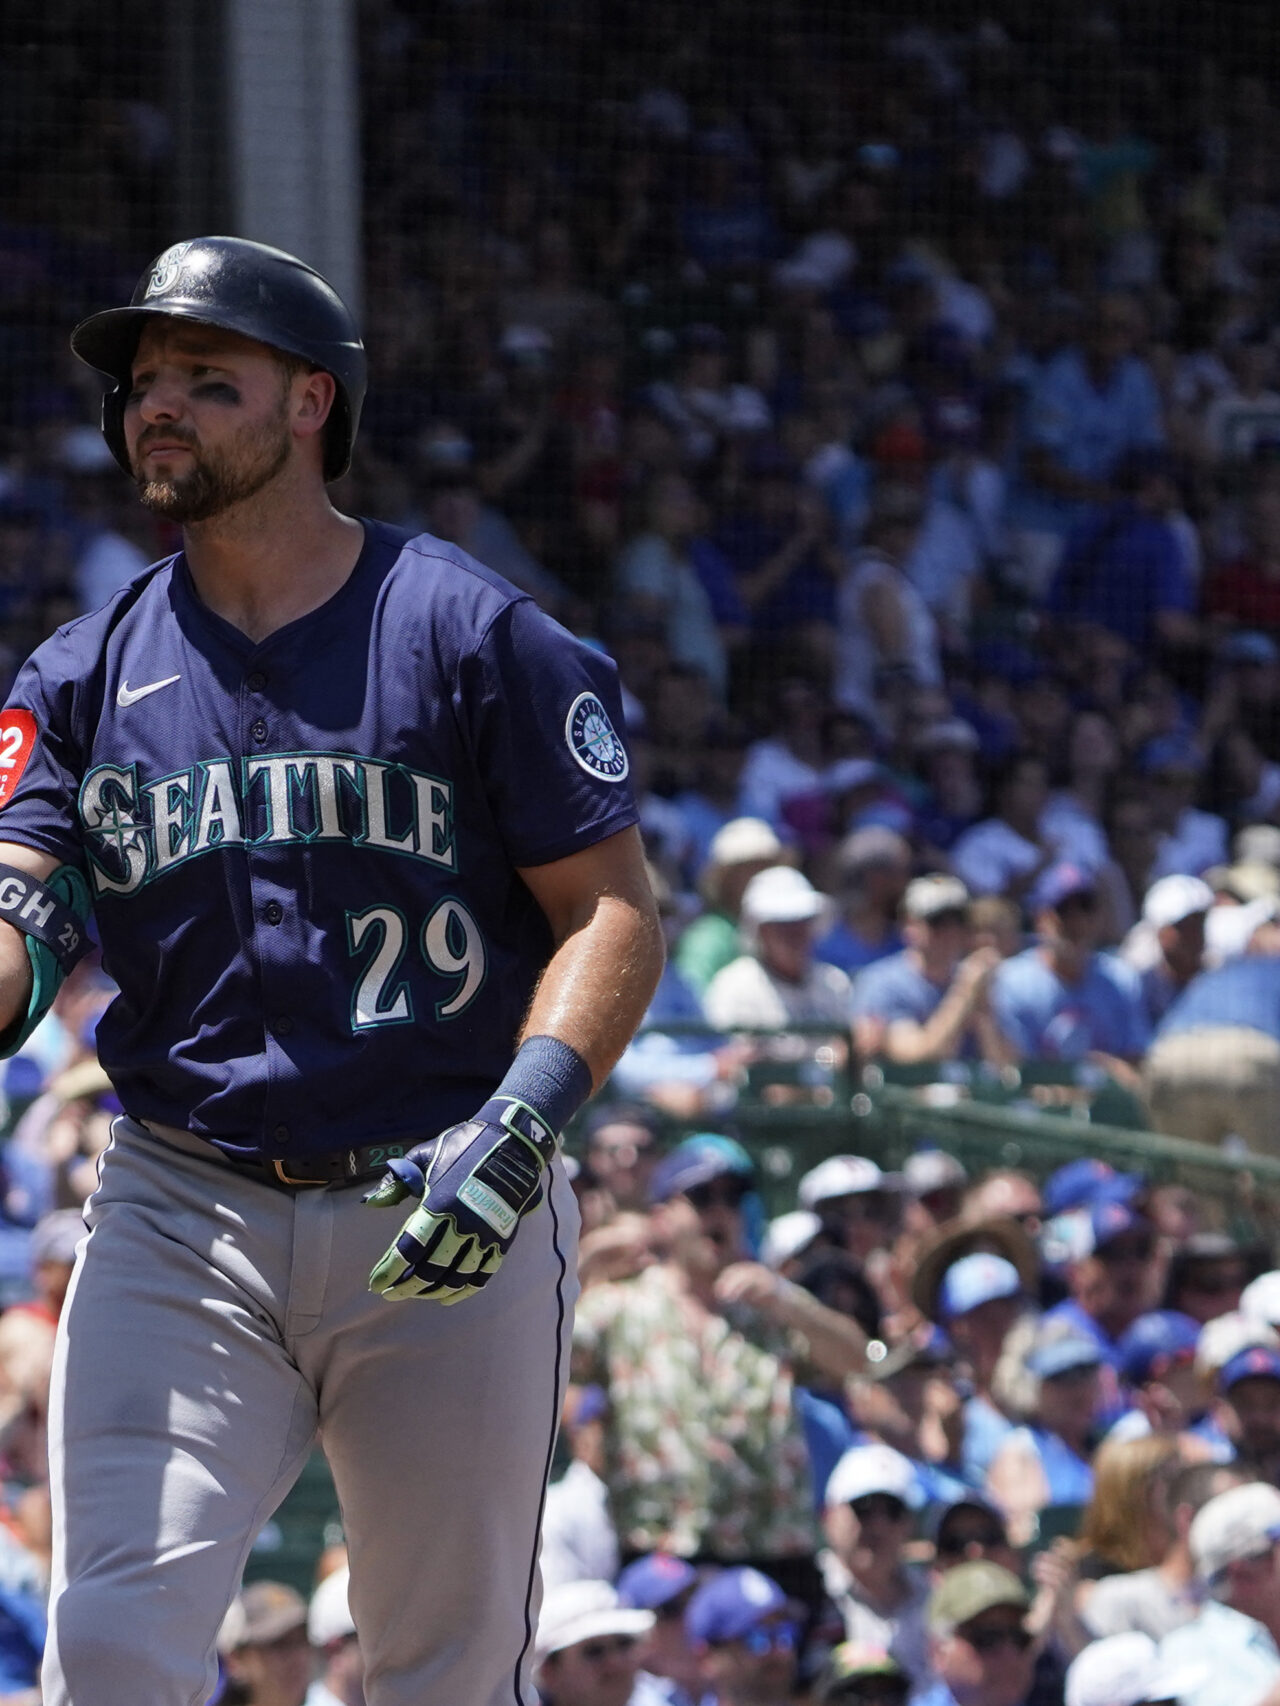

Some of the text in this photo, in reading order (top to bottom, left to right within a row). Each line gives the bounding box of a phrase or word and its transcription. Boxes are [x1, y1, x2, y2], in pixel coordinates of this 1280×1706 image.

[78, 751, 459, 899] SEATTLE
[58, 922, 80, 953] 29
[345, 895, 488, 1030] 29
[369, 1145, 403, 1167] 29
